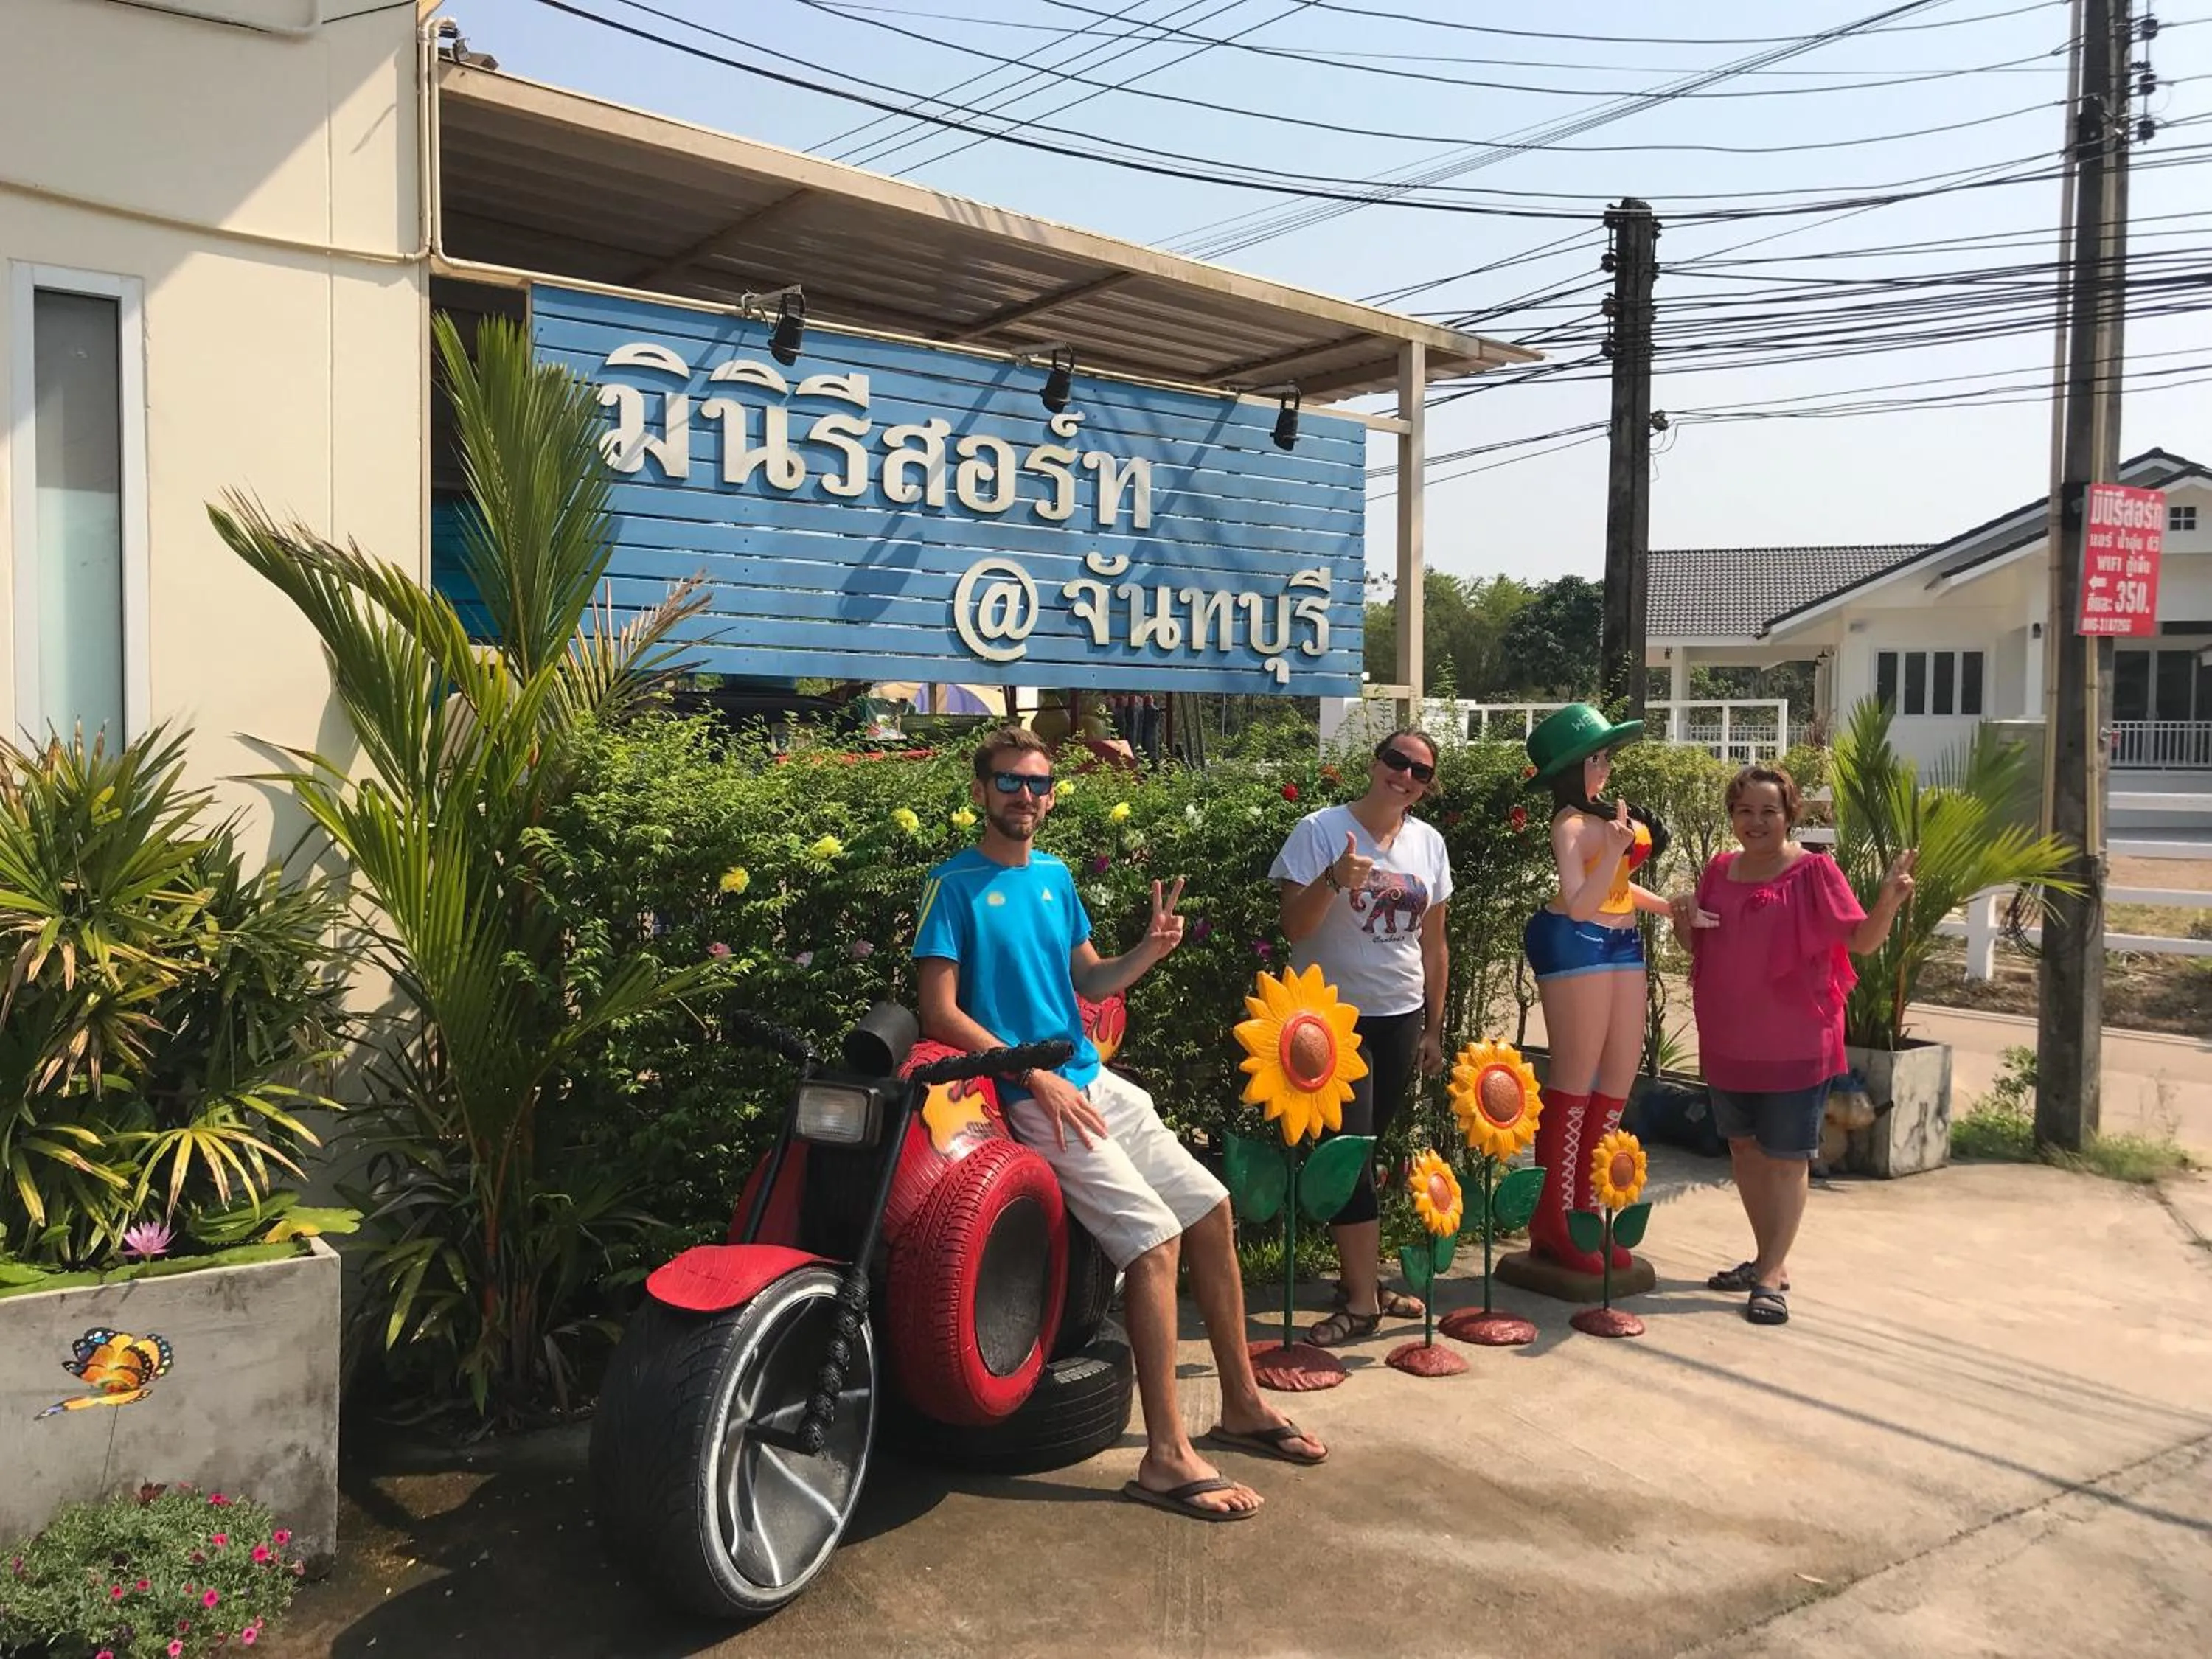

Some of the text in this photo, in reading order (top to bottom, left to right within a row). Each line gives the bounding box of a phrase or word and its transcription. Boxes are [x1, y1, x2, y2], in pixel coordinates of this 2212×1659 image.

[597, 343, 1152, 529] มินิรีสอร์ท
[954, 552, 1332, 684] @ จันทบุรี
[2097, 555, 2121, 572] WIFI
